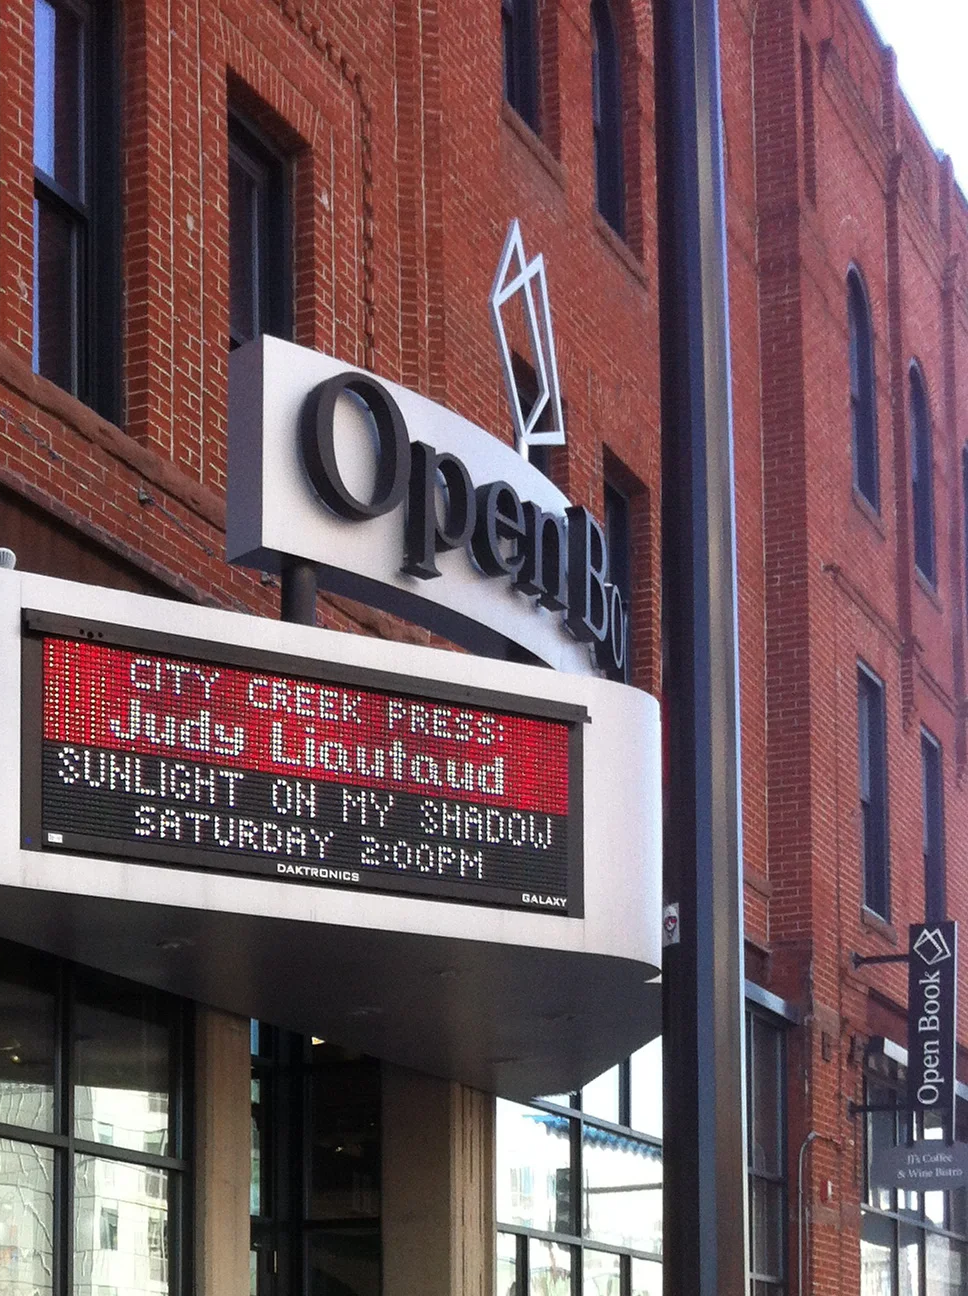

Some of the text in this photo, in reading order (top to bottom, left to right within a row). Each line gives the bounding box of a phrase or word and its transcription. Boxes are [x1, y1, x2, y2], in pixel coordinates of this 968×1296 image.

[128, 657, 221, 699] CITY
[246, 677, 362, 725] CREEK
[109, 698, 245, 756] Judy
[58, 746, 553, 850] SUNLIGHT ON MY SHADOW
[134, 805, 484, 880] SATURDAY 2:00PM
[277, 862, 360, 883] DAKTRONICS
[521, 892, 568, 908] GALAXY
[917, 969, 944, 1105] Open Book
[908, 1168, 934, 1179] Wine
[922, 1152, 954, 1164] Coffee
